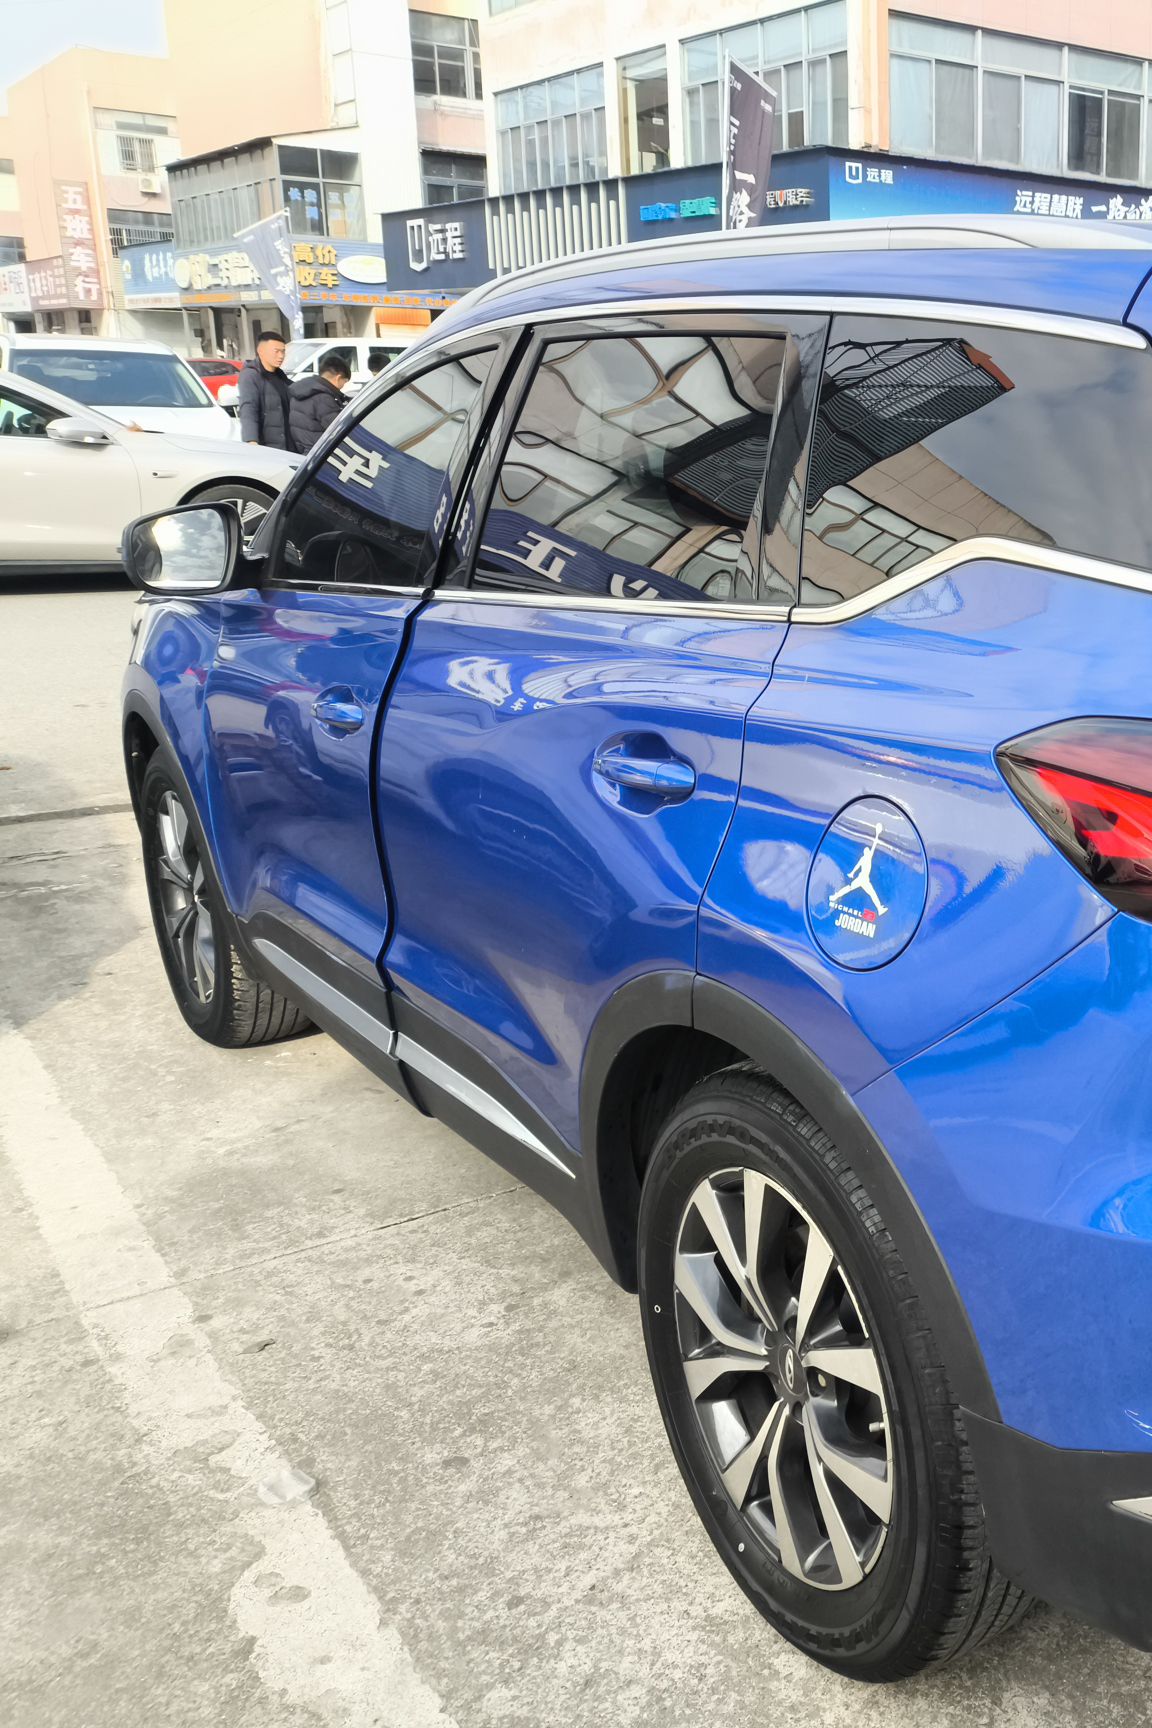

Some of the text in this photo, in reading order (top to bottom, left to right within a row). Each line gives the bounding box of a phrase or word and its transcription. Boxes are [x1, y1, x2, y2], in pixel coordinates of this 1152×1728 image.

[866, 167, 894, 185] 远程
[1013, 189, 1084, 219] 远程慧联
[428, 221, 465, 261] 远程
[294, 243, 337, 265] 高价
[296, 266, 340, 289] 收车
[834, 913, 876, 938] JORDAN
